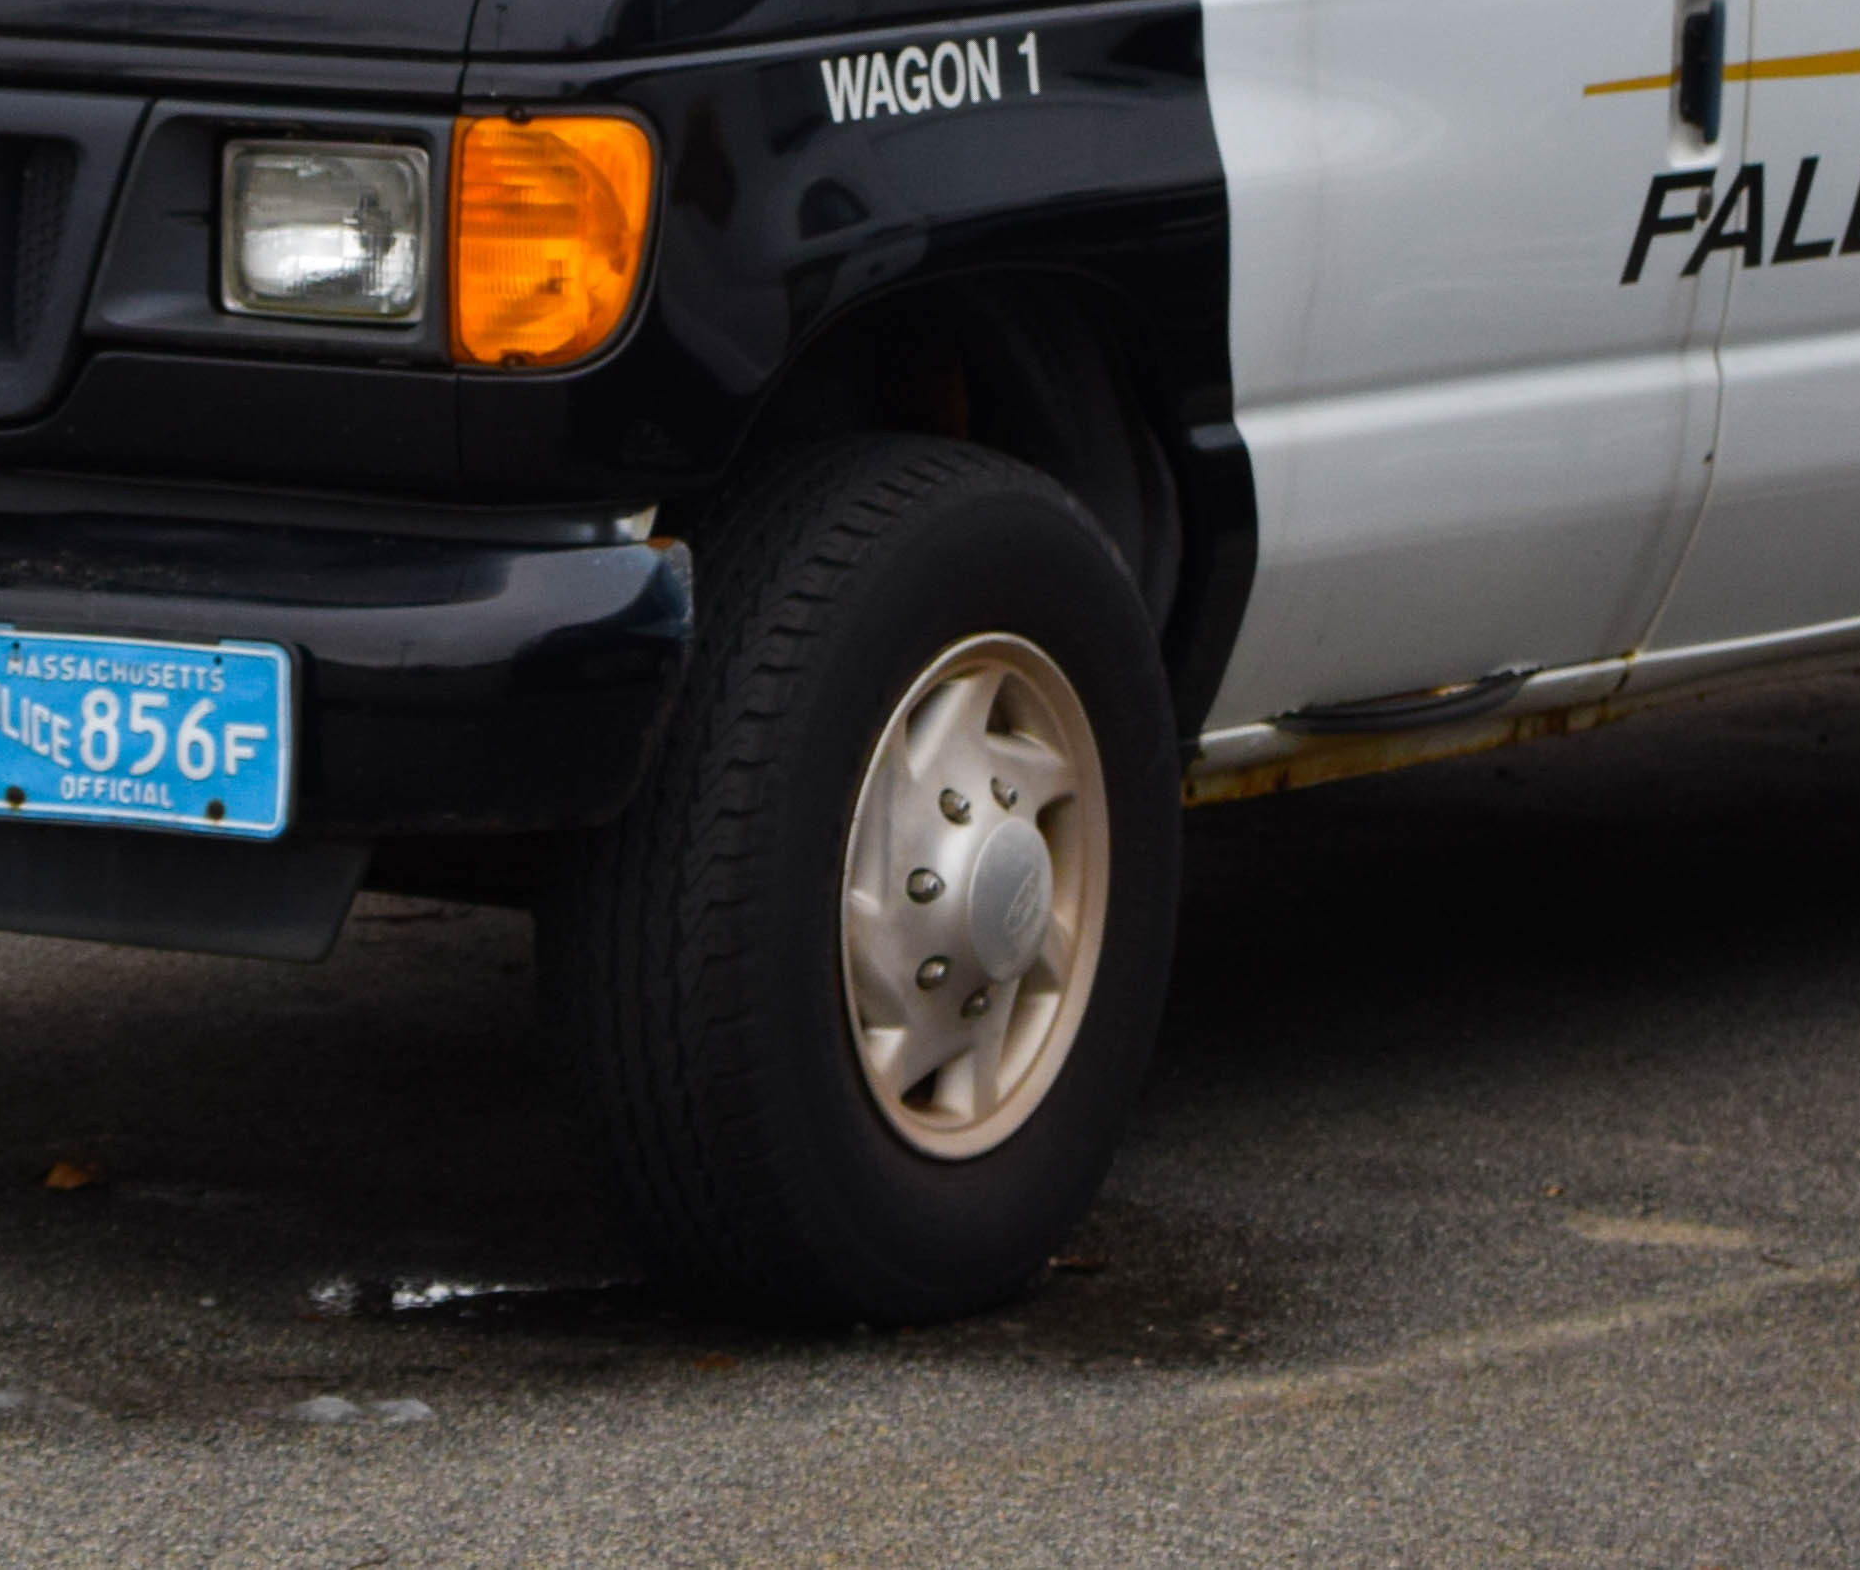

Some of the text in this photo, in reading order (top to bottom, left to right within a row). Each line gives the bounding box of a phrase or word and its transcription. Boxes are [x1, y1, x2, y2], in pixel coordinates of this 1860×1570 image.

[820, 32, 1041, 124] WAGON 1
[5, 654, 226, 695] MASSACHUSETTS
[77, 686, 270, 782] 856F
[58, 774, 175, 810] OFFICIAL
